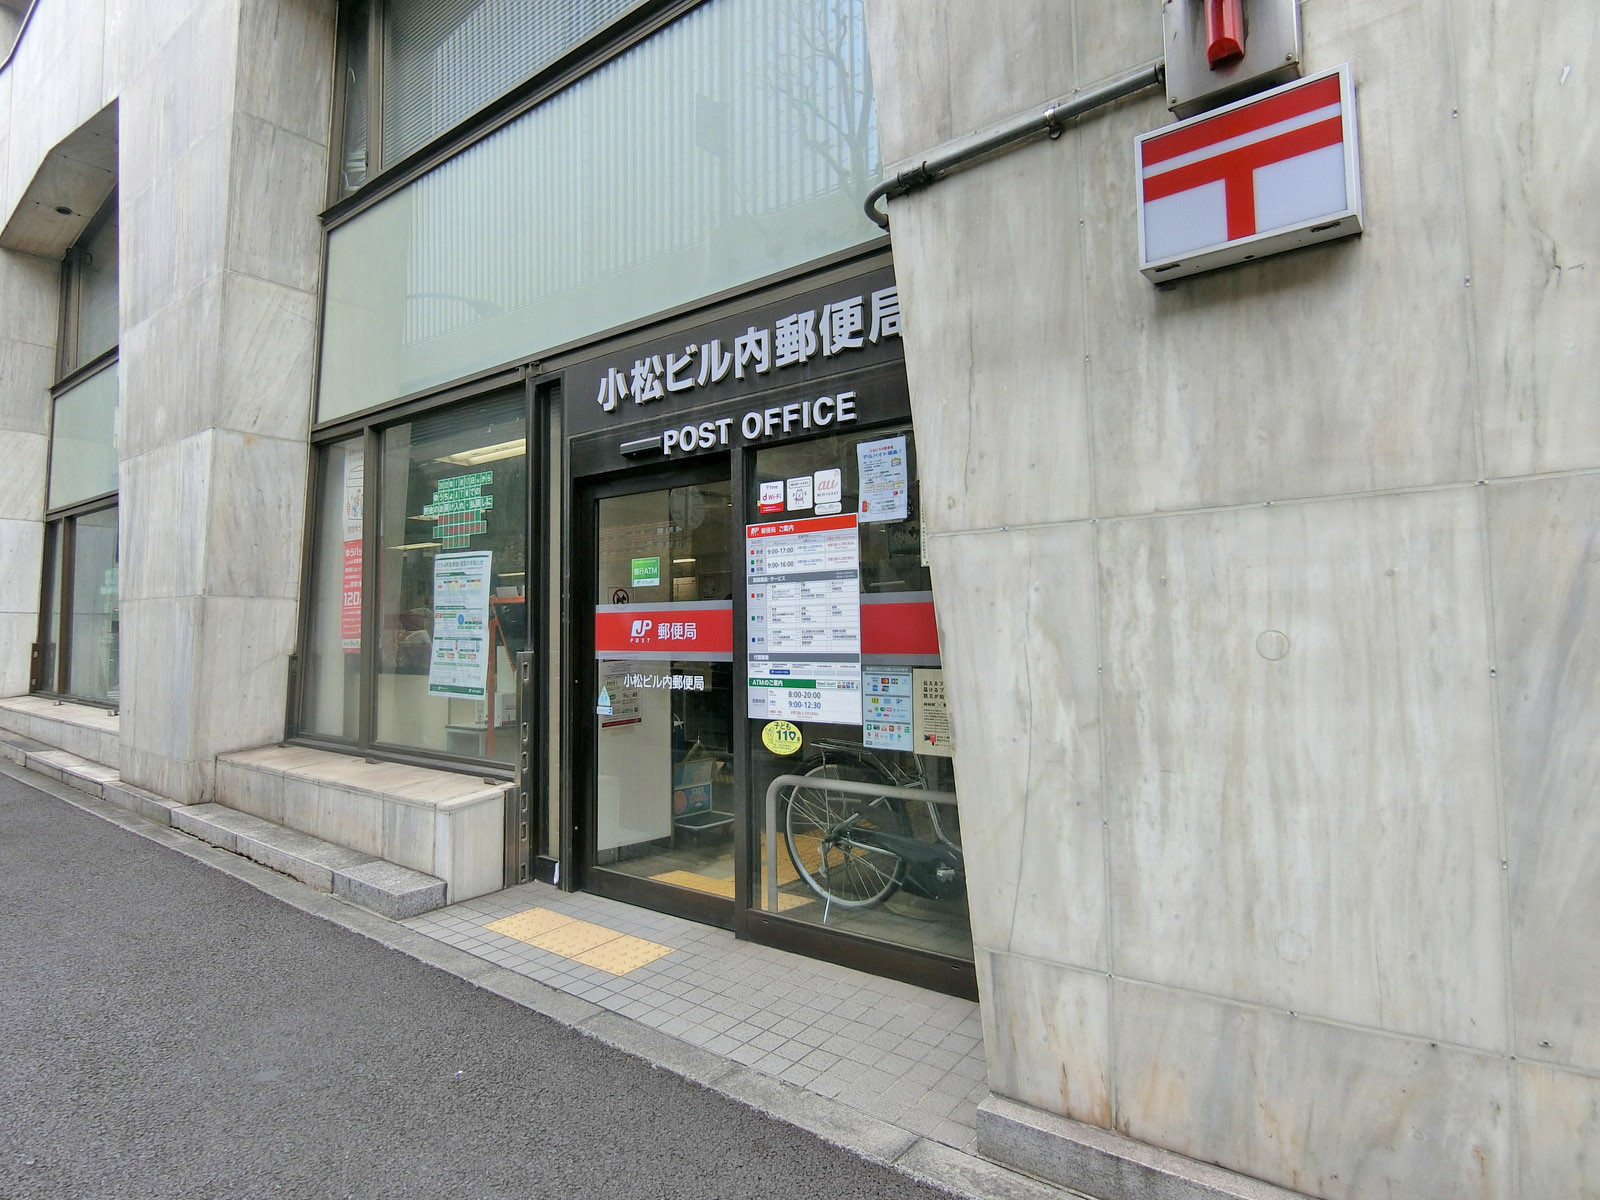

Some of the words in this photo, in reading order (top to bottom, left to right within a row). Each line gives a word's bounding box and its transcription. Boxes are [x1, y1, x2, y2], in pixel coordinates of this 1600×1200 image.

[597, 286, 903, 412] 小松ビル内郵便局
[663, 417, 733, 455] POST
[742, 390, 857, 441] OFFICE
[817, 479, 838, 491] au
[761, 526, 776, 534] 郵便局
[779, 524, 794, 533] ご案内
[767, 547, 794, 556] 9:00-17:00
[767, 561, 794, 569] 9:00-16:00
[657, 622, 697, 641] 郵便局
[623, 673, 705, 691] 小松ビル内郵便局
[752, 679, 783, 687] ATMのご案内
[788, 690, 821, 700] 8:00-20:00
[788, 700, 822, 710] 9:00-12:30
[774, 721, 791, 731] 子ども
